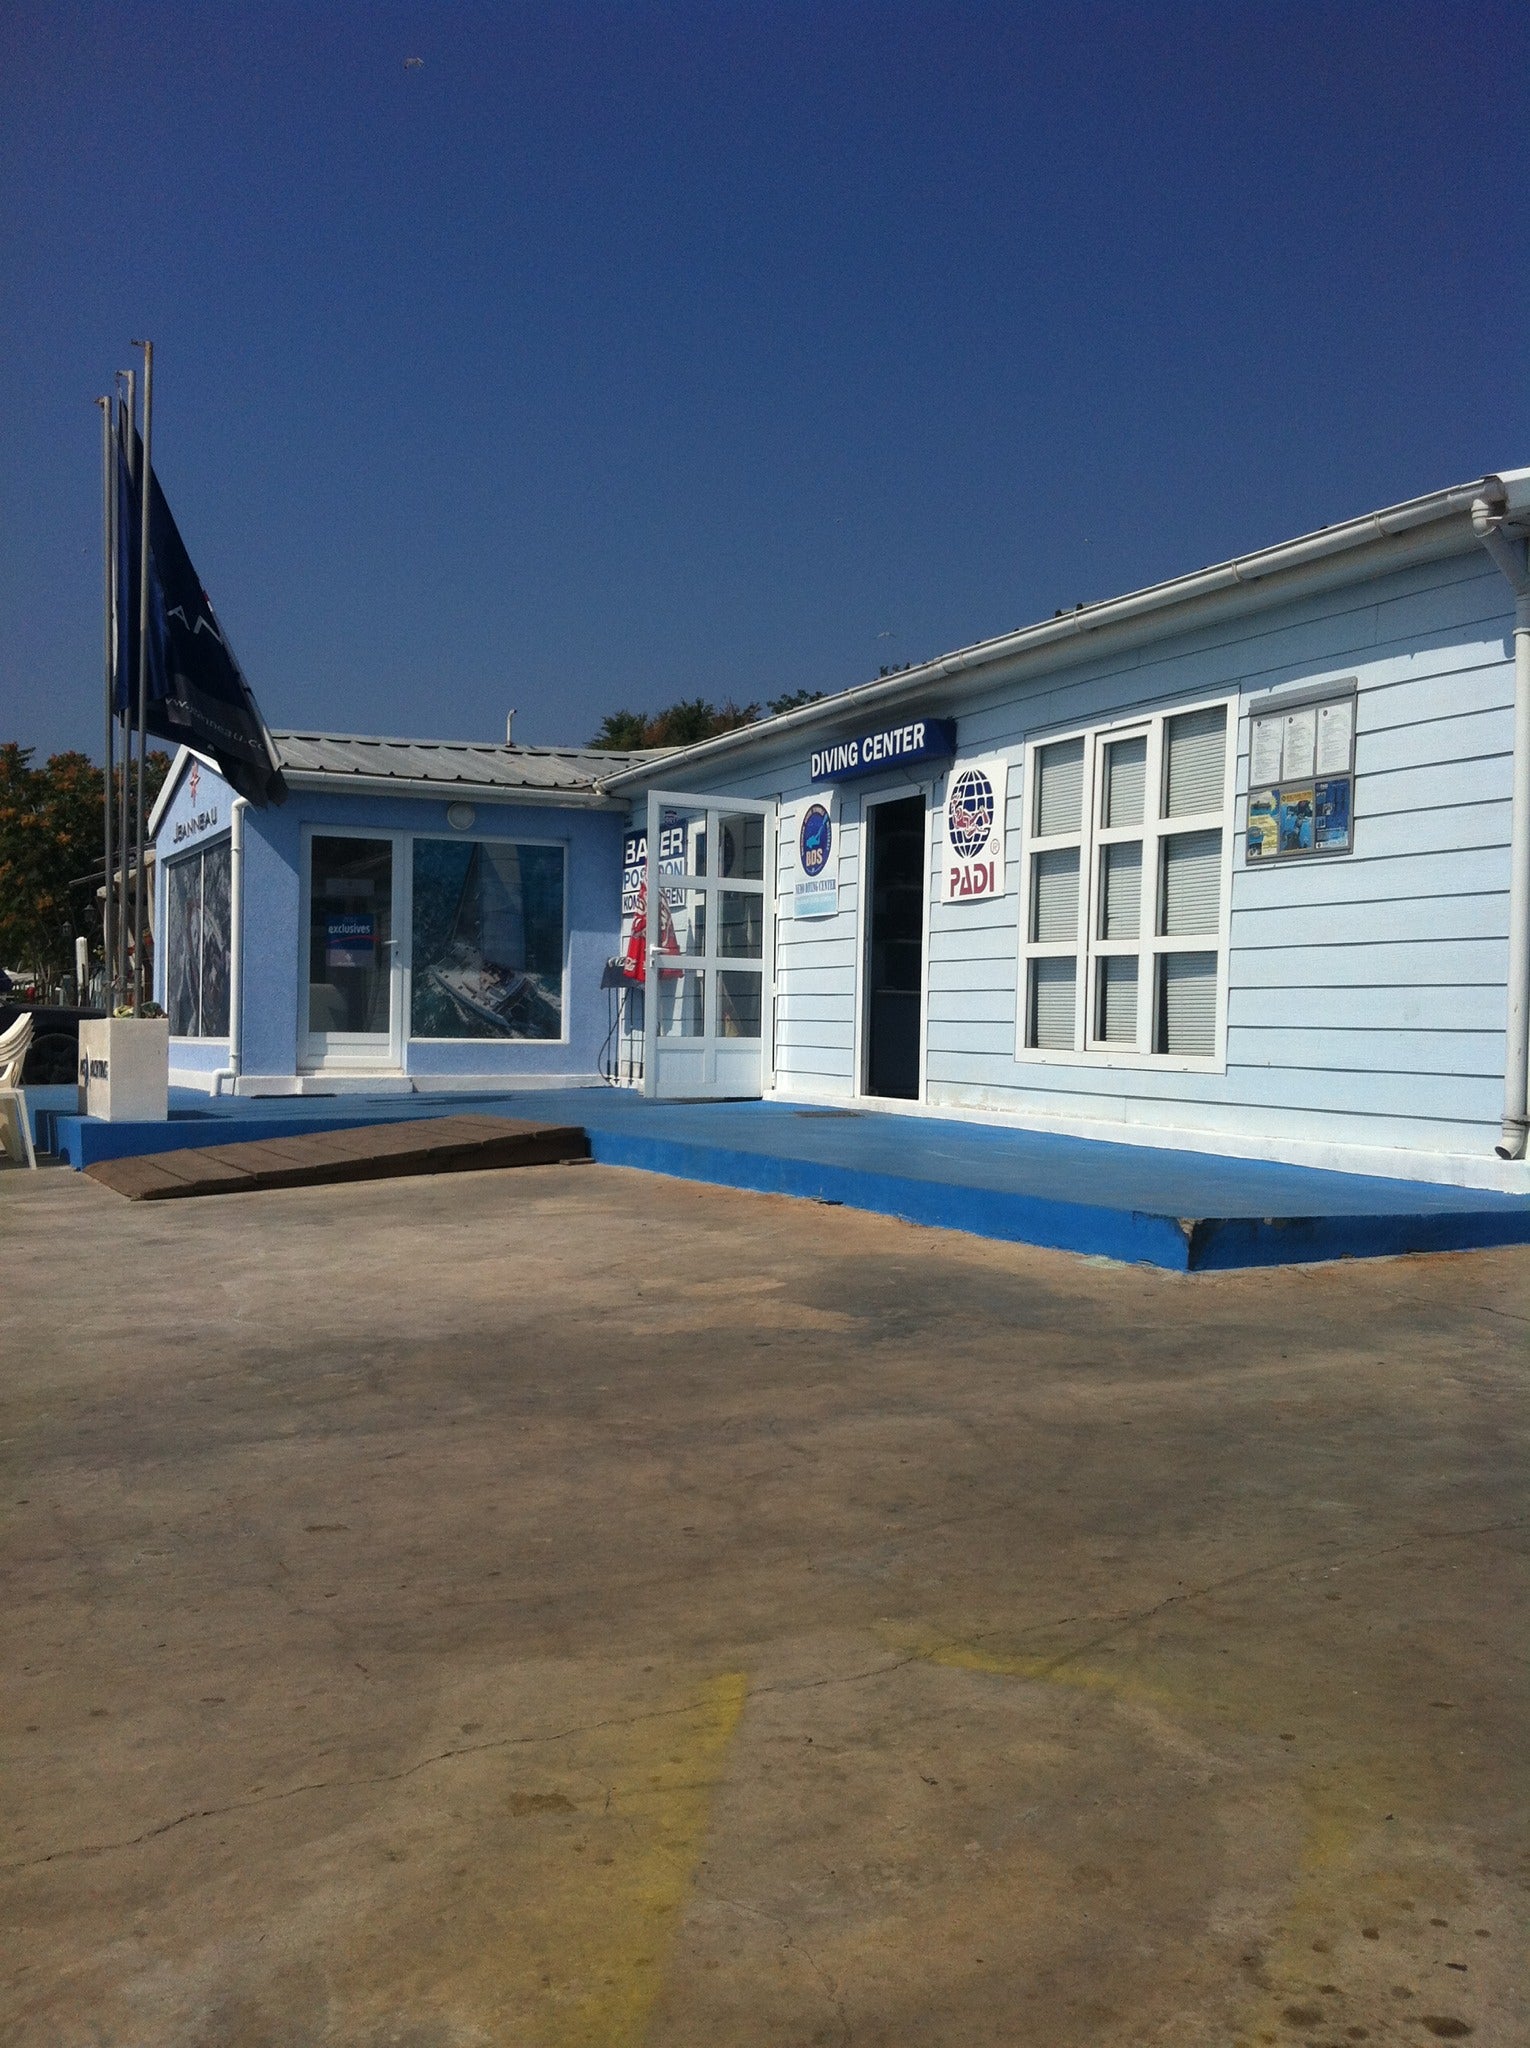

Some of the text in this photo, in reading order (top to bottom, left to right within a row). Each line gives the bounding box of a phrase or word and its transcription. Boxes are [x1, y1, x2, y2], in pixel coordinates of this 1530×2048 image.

[811, 722, 925, 777] DIVING CENTER
[625, 827, 682, 864] BAER
[806, 848, 823, 867] BDS
[950, 861, 995, 898] PADI
[328, 923, 371, 934] exclusives
